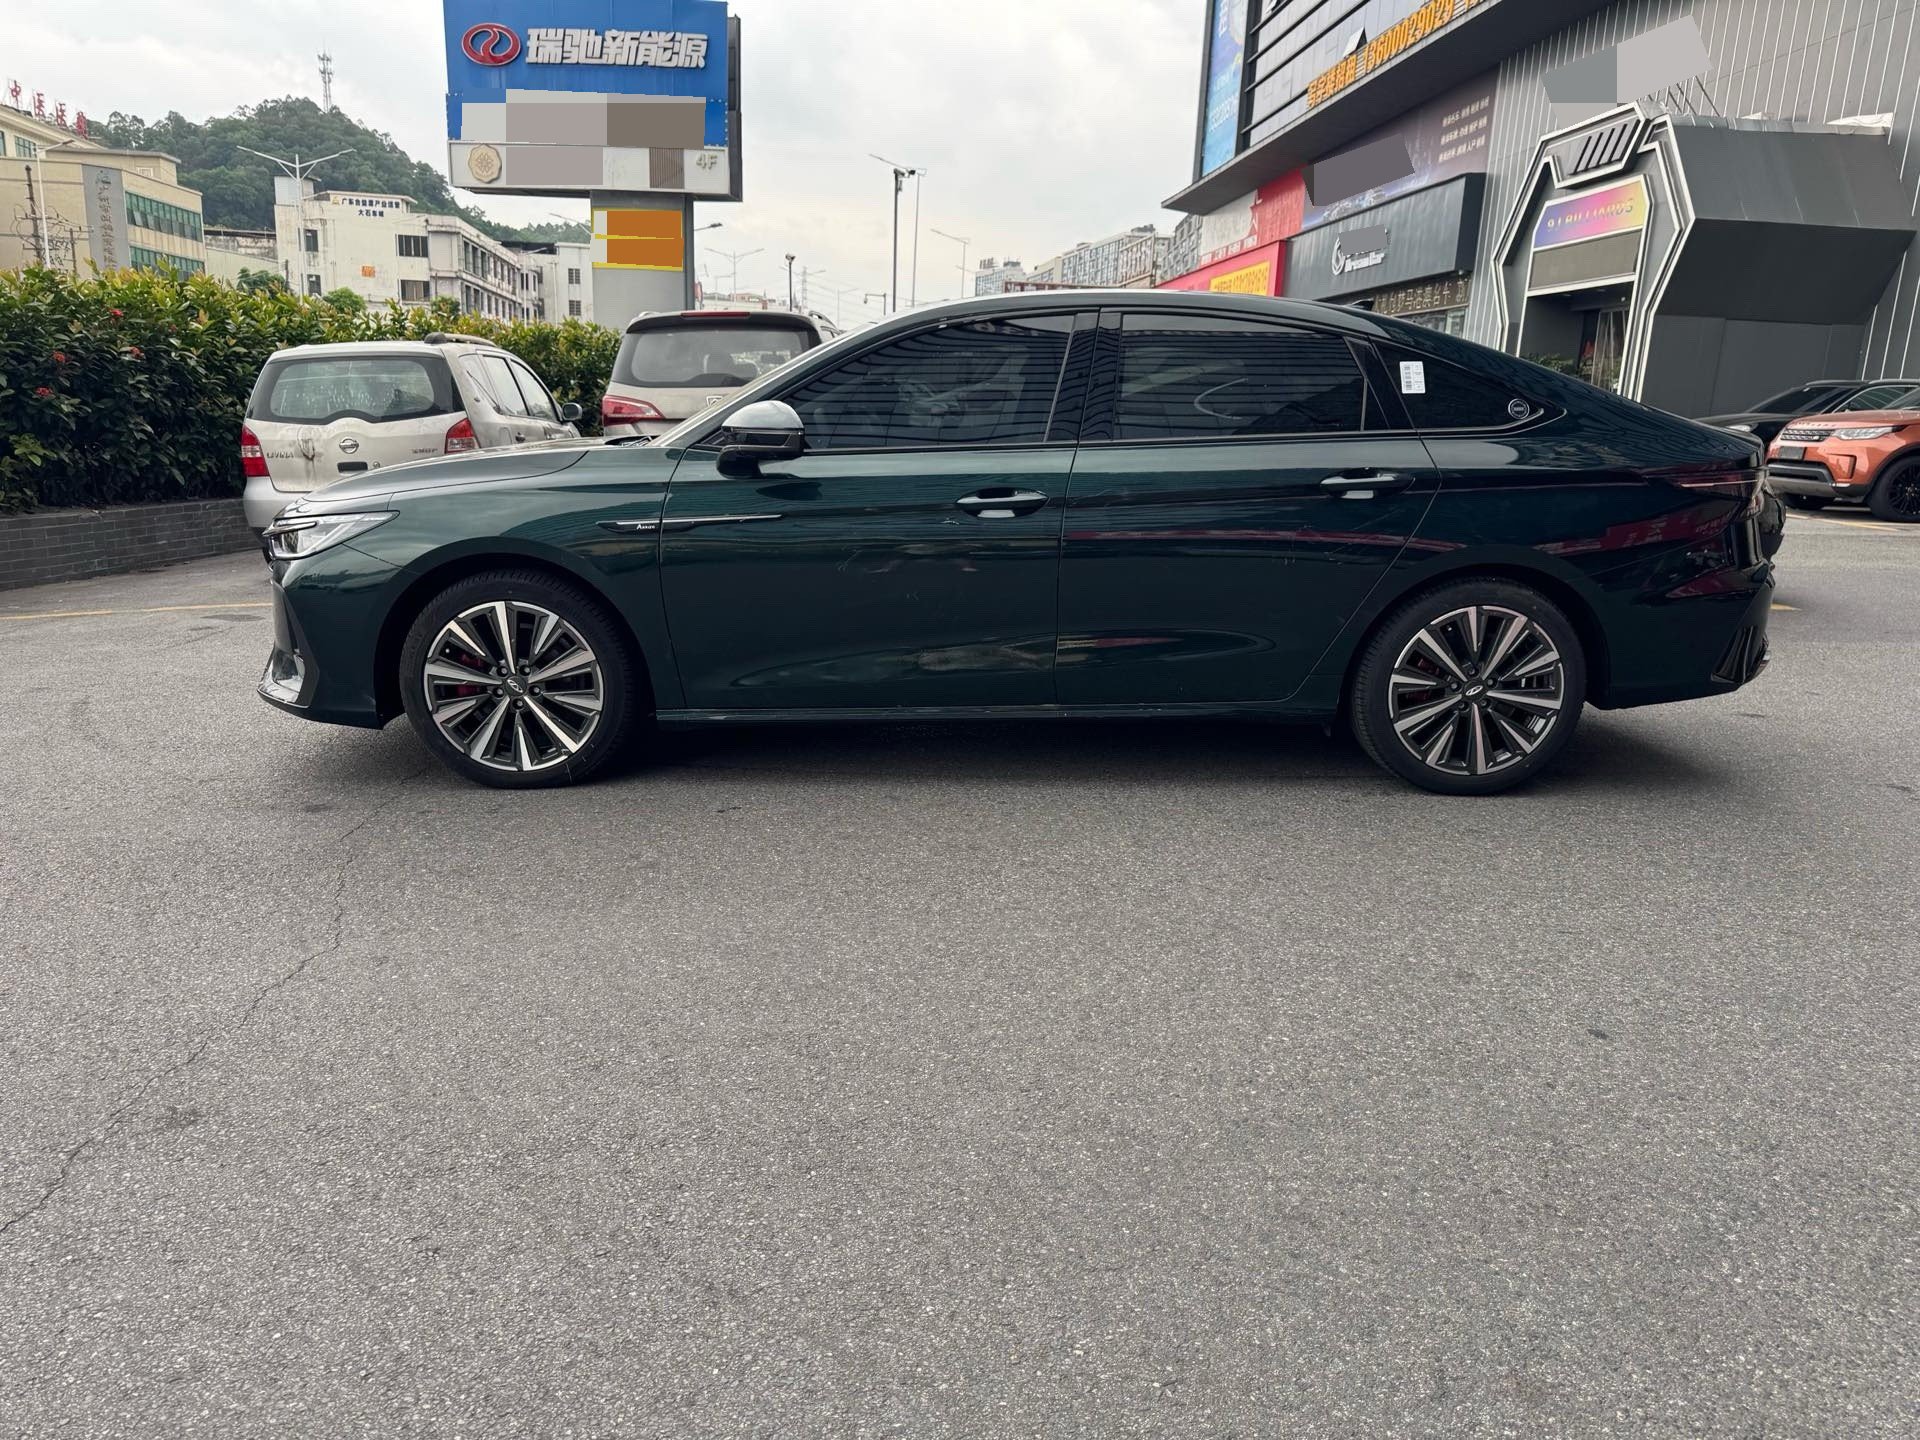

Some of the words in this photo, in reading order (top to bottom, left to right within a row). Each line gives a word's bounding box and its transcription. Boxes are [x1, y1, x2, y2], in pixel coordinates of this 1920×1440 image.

[526, 28, 708, 69] 瑞驰新能源
[696, 153, 718, 170] 4F
